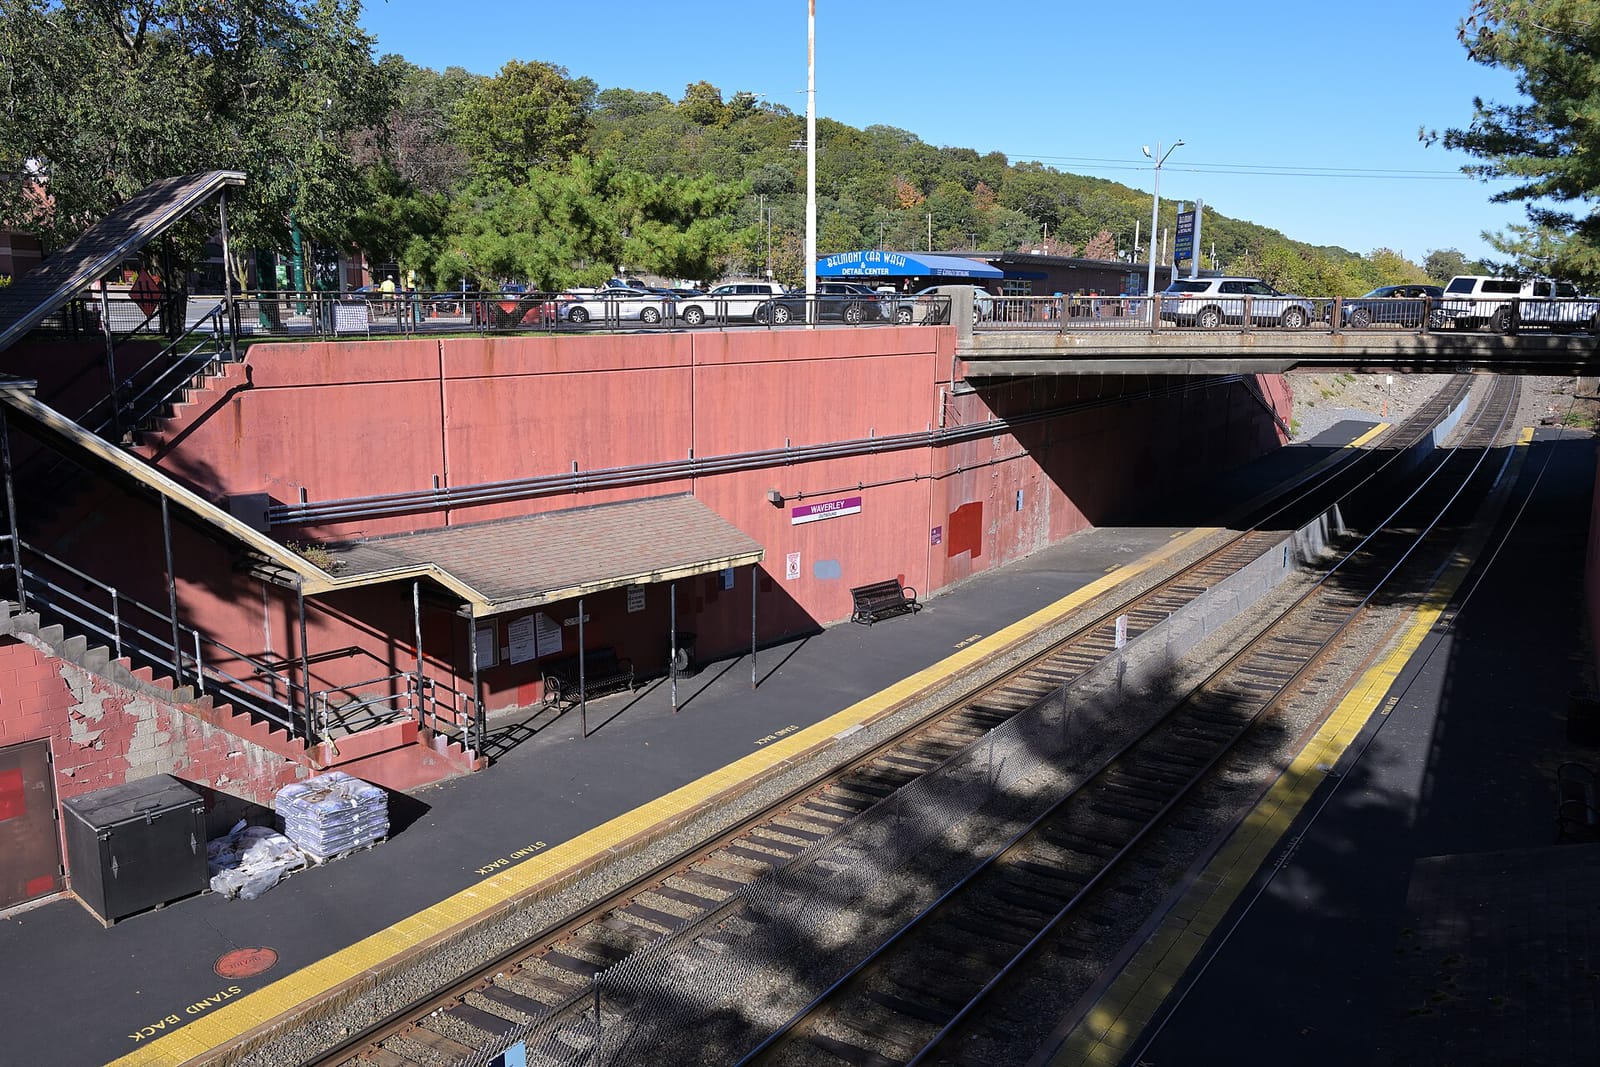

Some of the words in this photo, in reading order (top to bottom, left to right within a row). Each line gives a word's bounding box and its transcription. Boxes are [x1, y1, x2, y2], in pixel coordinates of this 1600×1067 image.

[827, 251, 863, 268] BELMONT
[865, 251, 881, 262] CAR
[883, 252, 906, 268] WASH
[810, 500, 845, 513] WAVERLEY
[509, 841, 547, 859] STAND
[474, 858, 510, 875] BACK
[186, 985, 242, 1015] STAND
[128, 1014, 181, 1042] BACK
